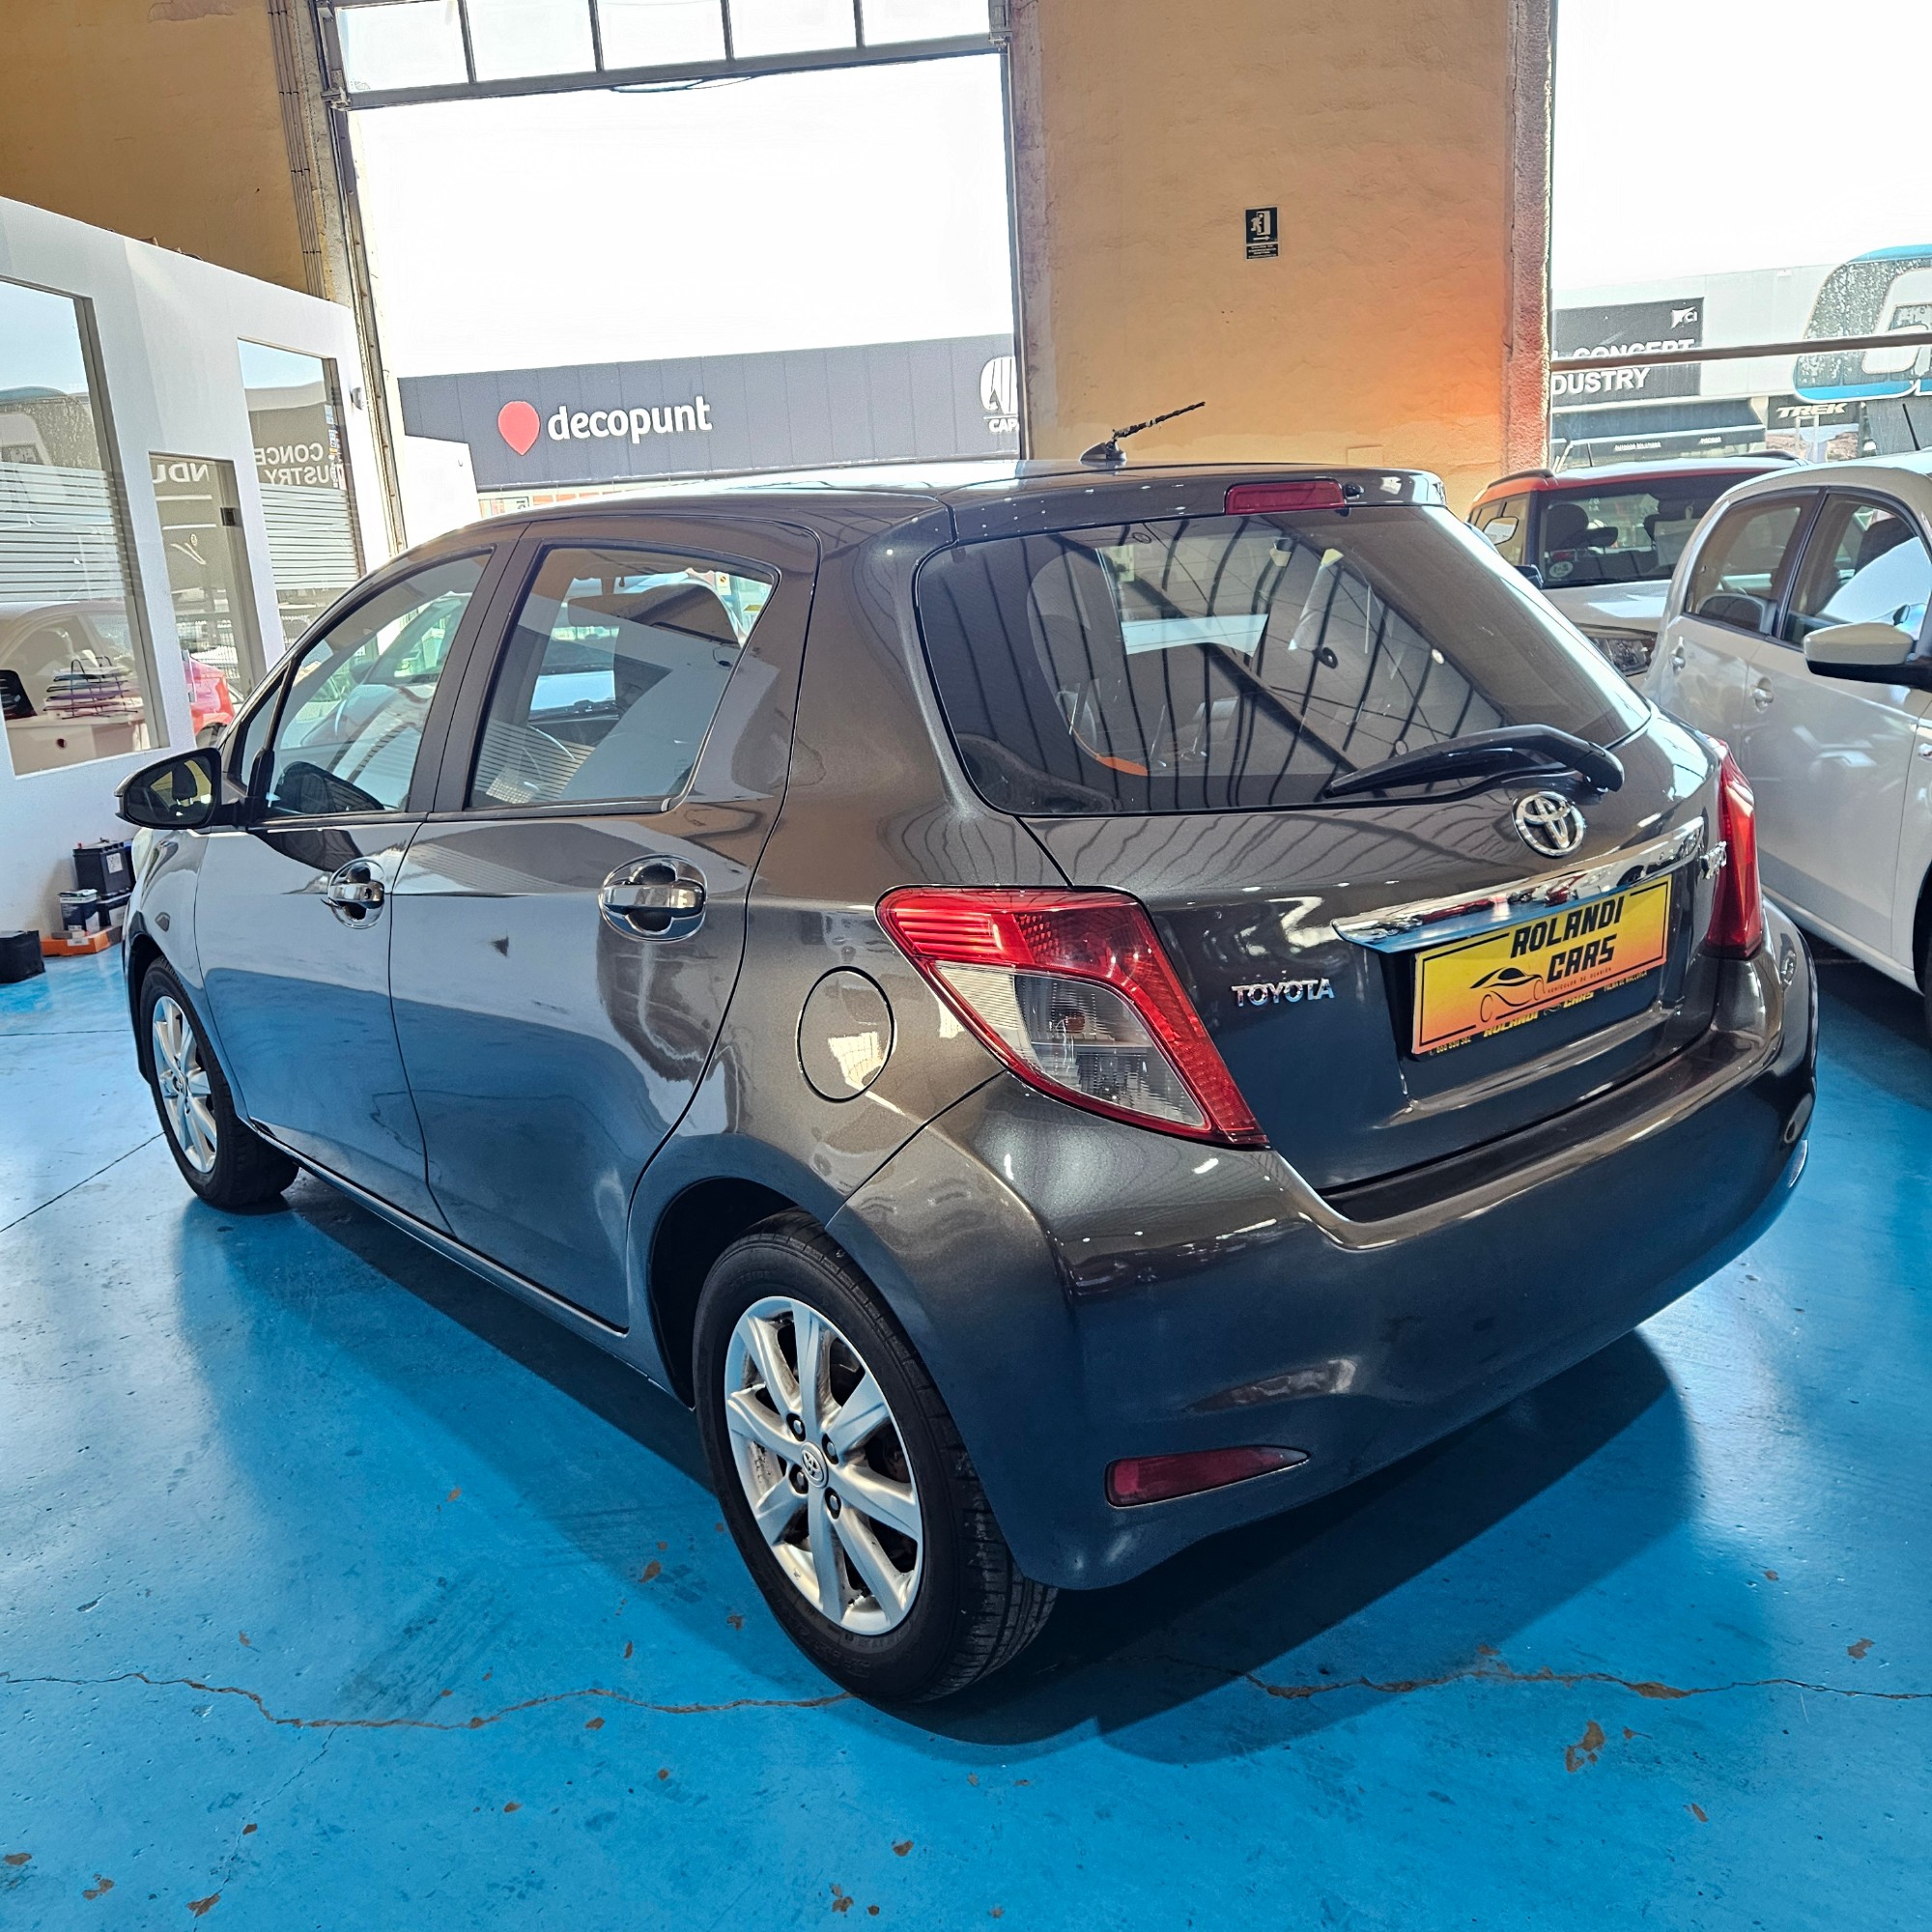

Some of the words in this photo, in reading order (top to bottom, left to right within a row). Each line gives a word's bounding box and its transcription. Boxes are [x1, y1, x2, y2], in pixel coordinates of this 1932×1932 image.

[547, 396, 713, 443] decopunt
[1776, 402, 1848, 418] TREK
[1510, 895, 1626, 959] ROLANDI
[1547, 932, 1618, 983] CARS
[1231, 978, 1336, 1008] TOYOTA
